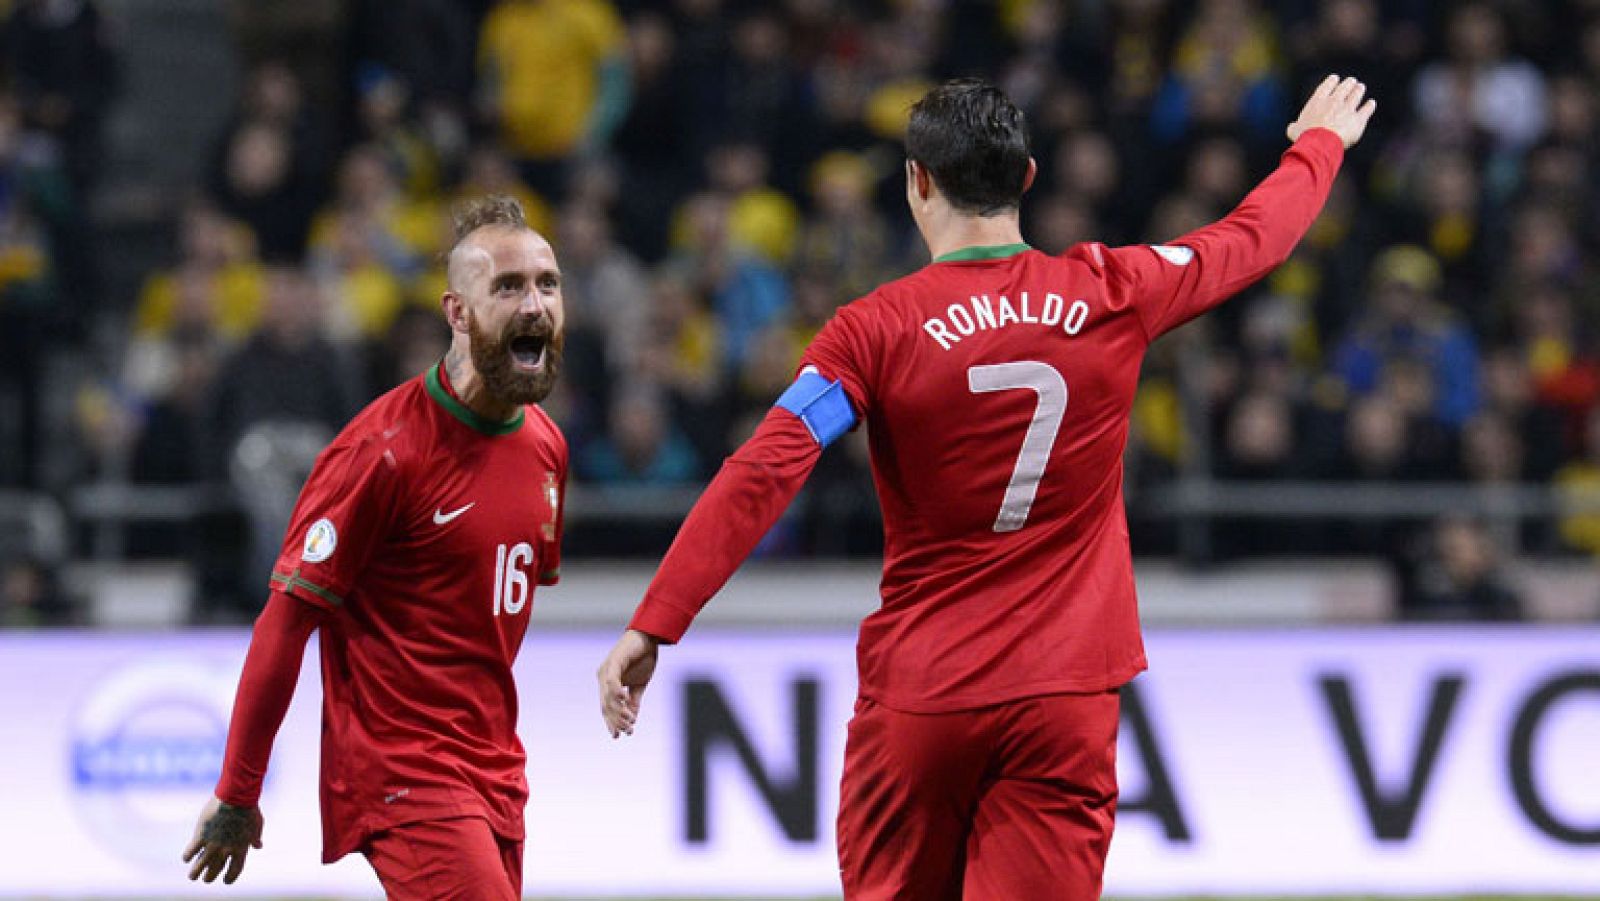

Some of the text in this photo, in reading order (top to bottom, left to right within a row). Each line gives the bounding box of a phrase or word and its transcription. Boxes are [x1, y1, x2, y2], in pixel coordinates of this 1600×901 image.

[923, 291, 1089, 351] RONALDO
[967, 360, 1068, 533] 7
[493, 541, 534, 616] 16
